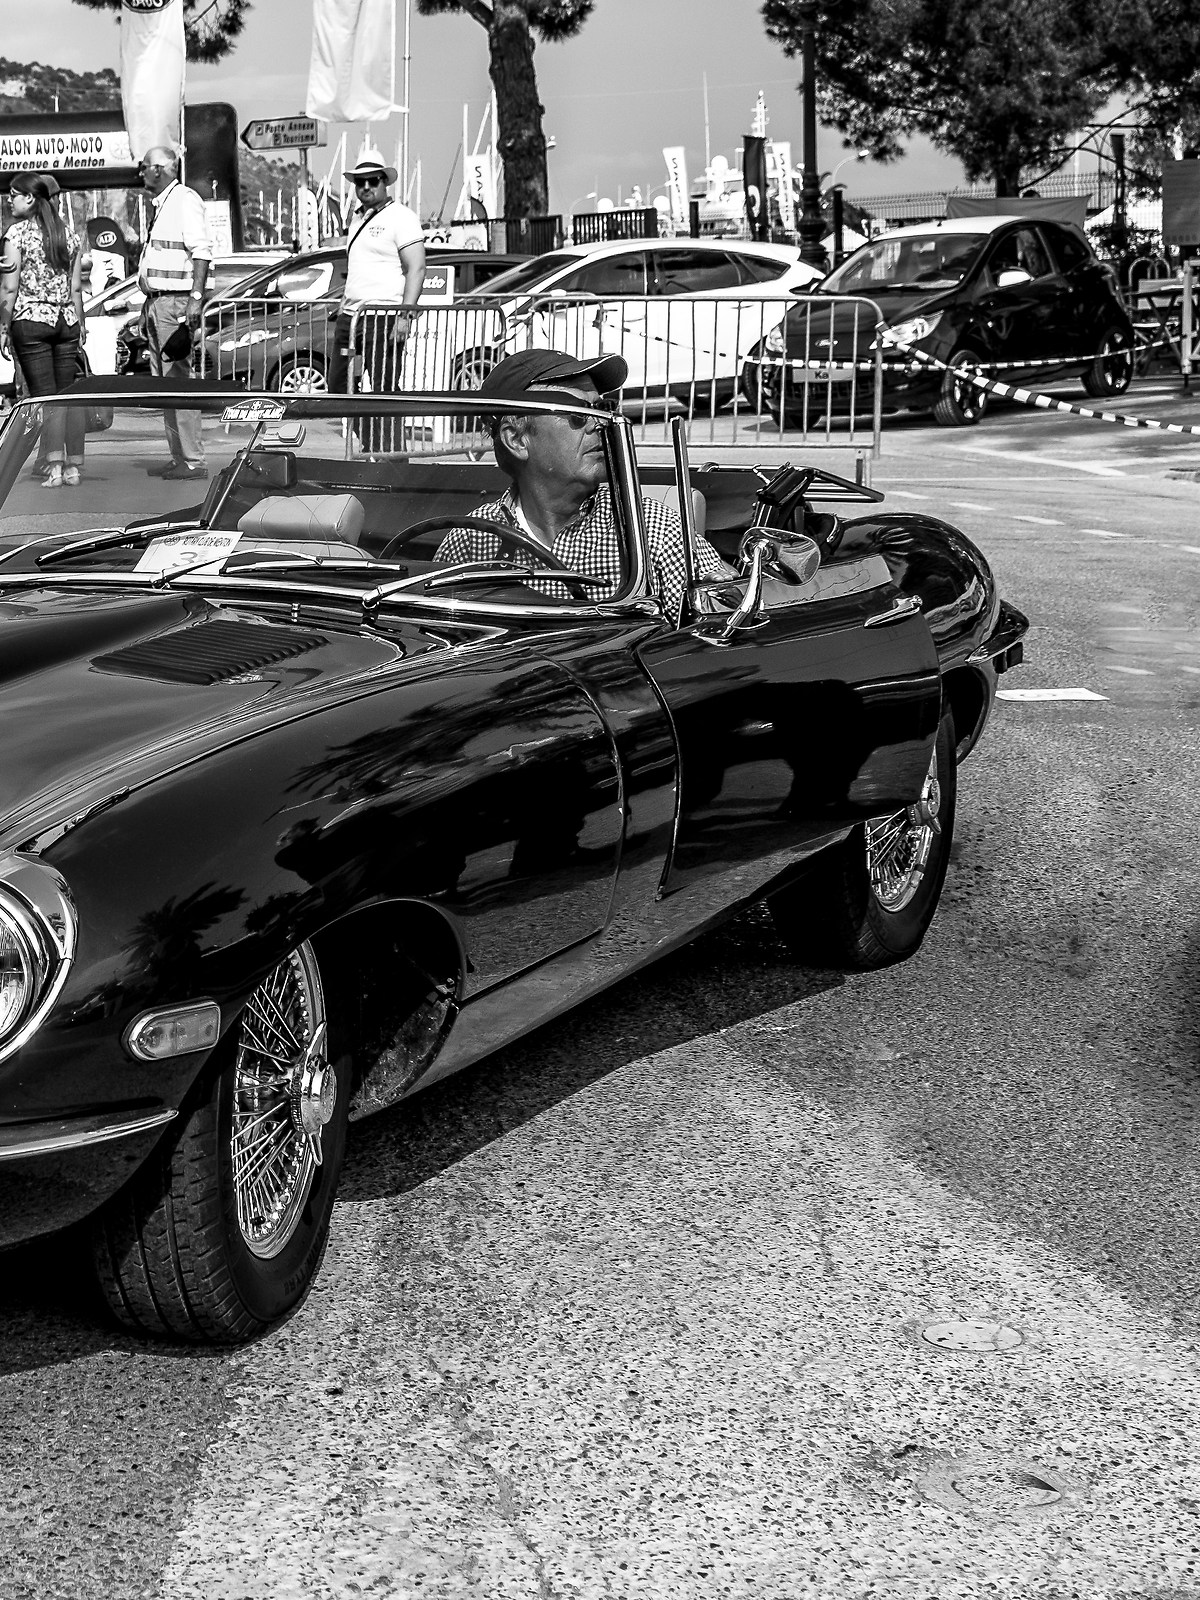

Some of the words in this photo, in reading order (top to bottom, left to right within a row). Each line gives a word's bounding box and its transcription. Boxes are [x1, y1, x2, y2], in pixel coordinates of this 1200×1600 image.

[282, 134, 314, 143] Tourisme
[52, 157, 60, 168] à
[63, 156, 105, 168] Menton
